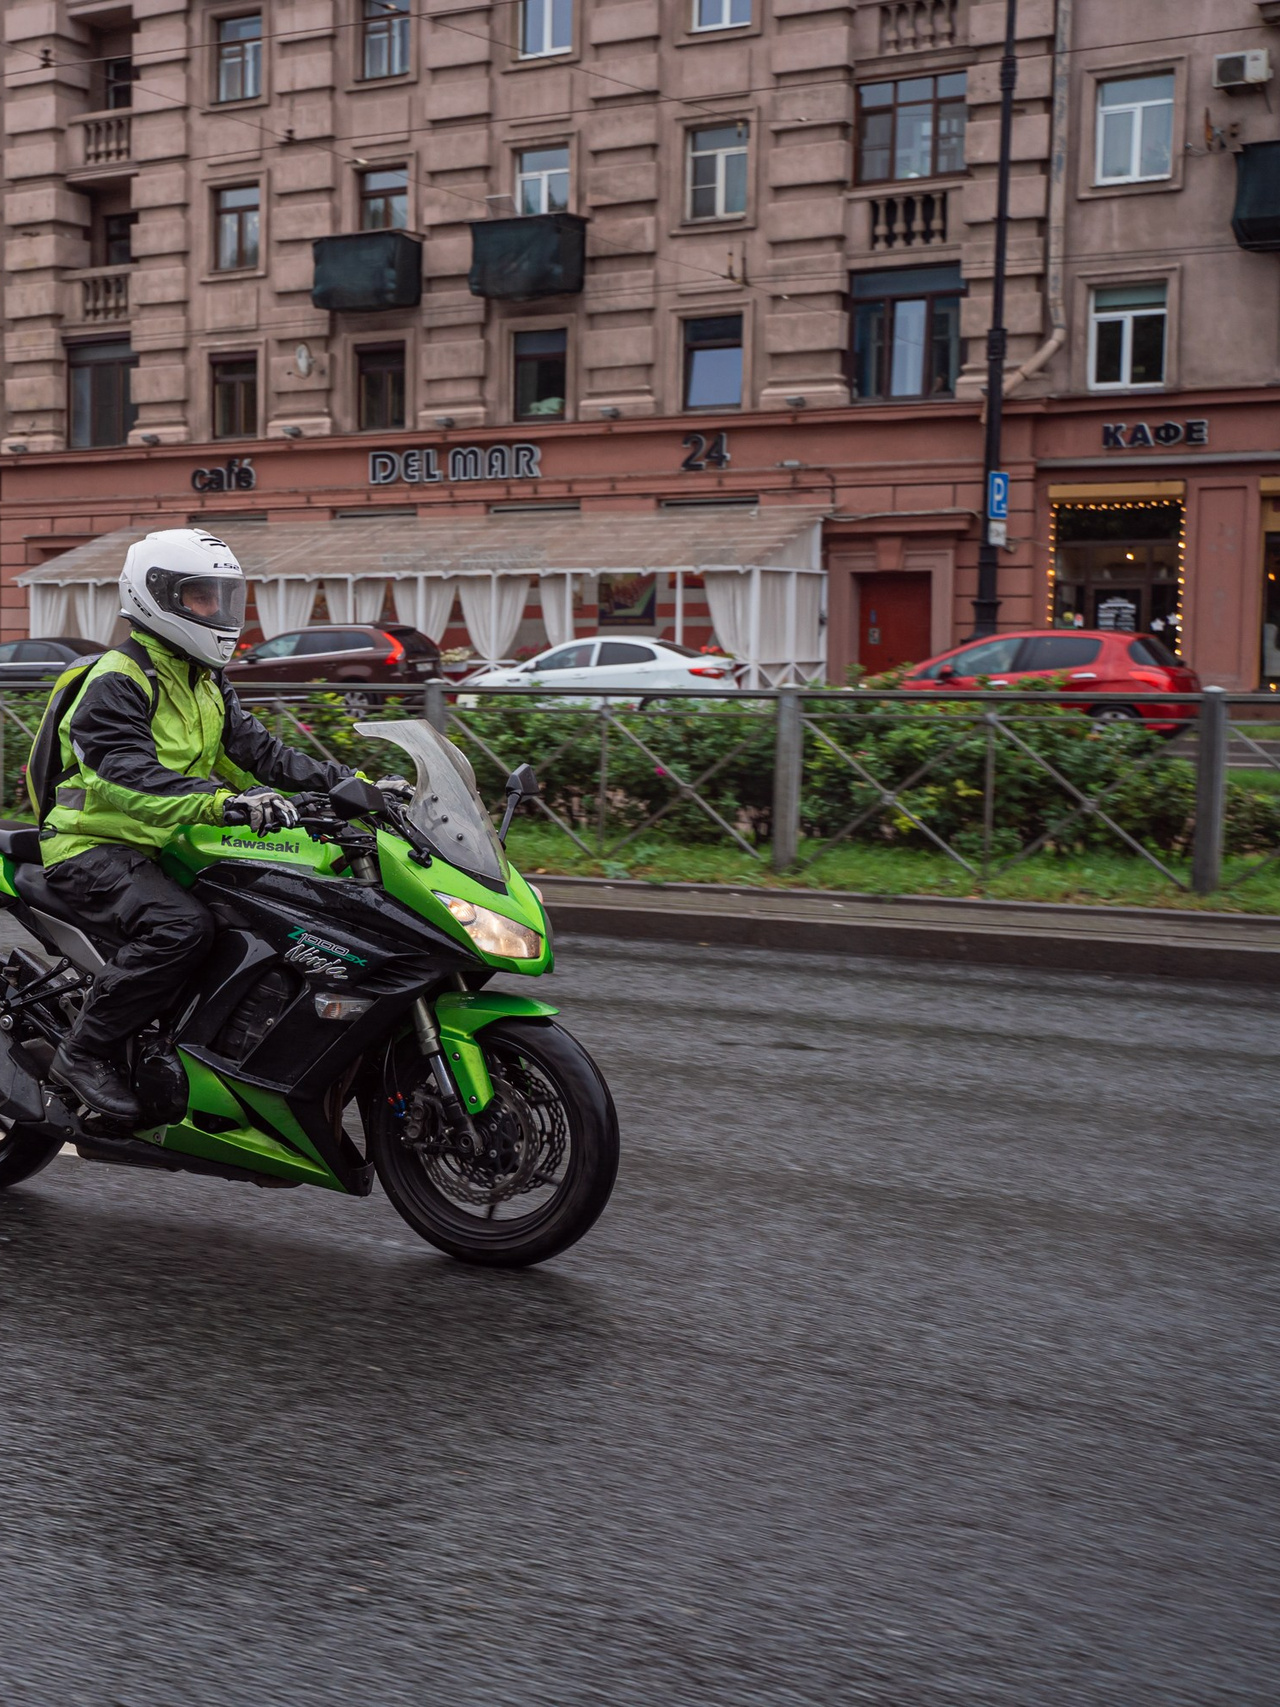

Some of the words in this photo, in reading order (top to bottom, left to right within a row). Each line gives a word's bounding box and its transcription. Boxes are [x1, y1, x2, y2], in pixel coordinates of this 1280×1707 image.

[1102, 418, 1209, 449] КАФЕ
[681, 432, 731, 471] 24
[190, 458, 256, 492] café
[369, 448, 443, 484] DEL
[448, 443, 542, 481] MAR
[213, 562, 240, 571] LS2
[127, 588, 153, 618] LS2
[221, 834, 300, 854] Kawasaki
[284, 943, 349, 980] Ninja
